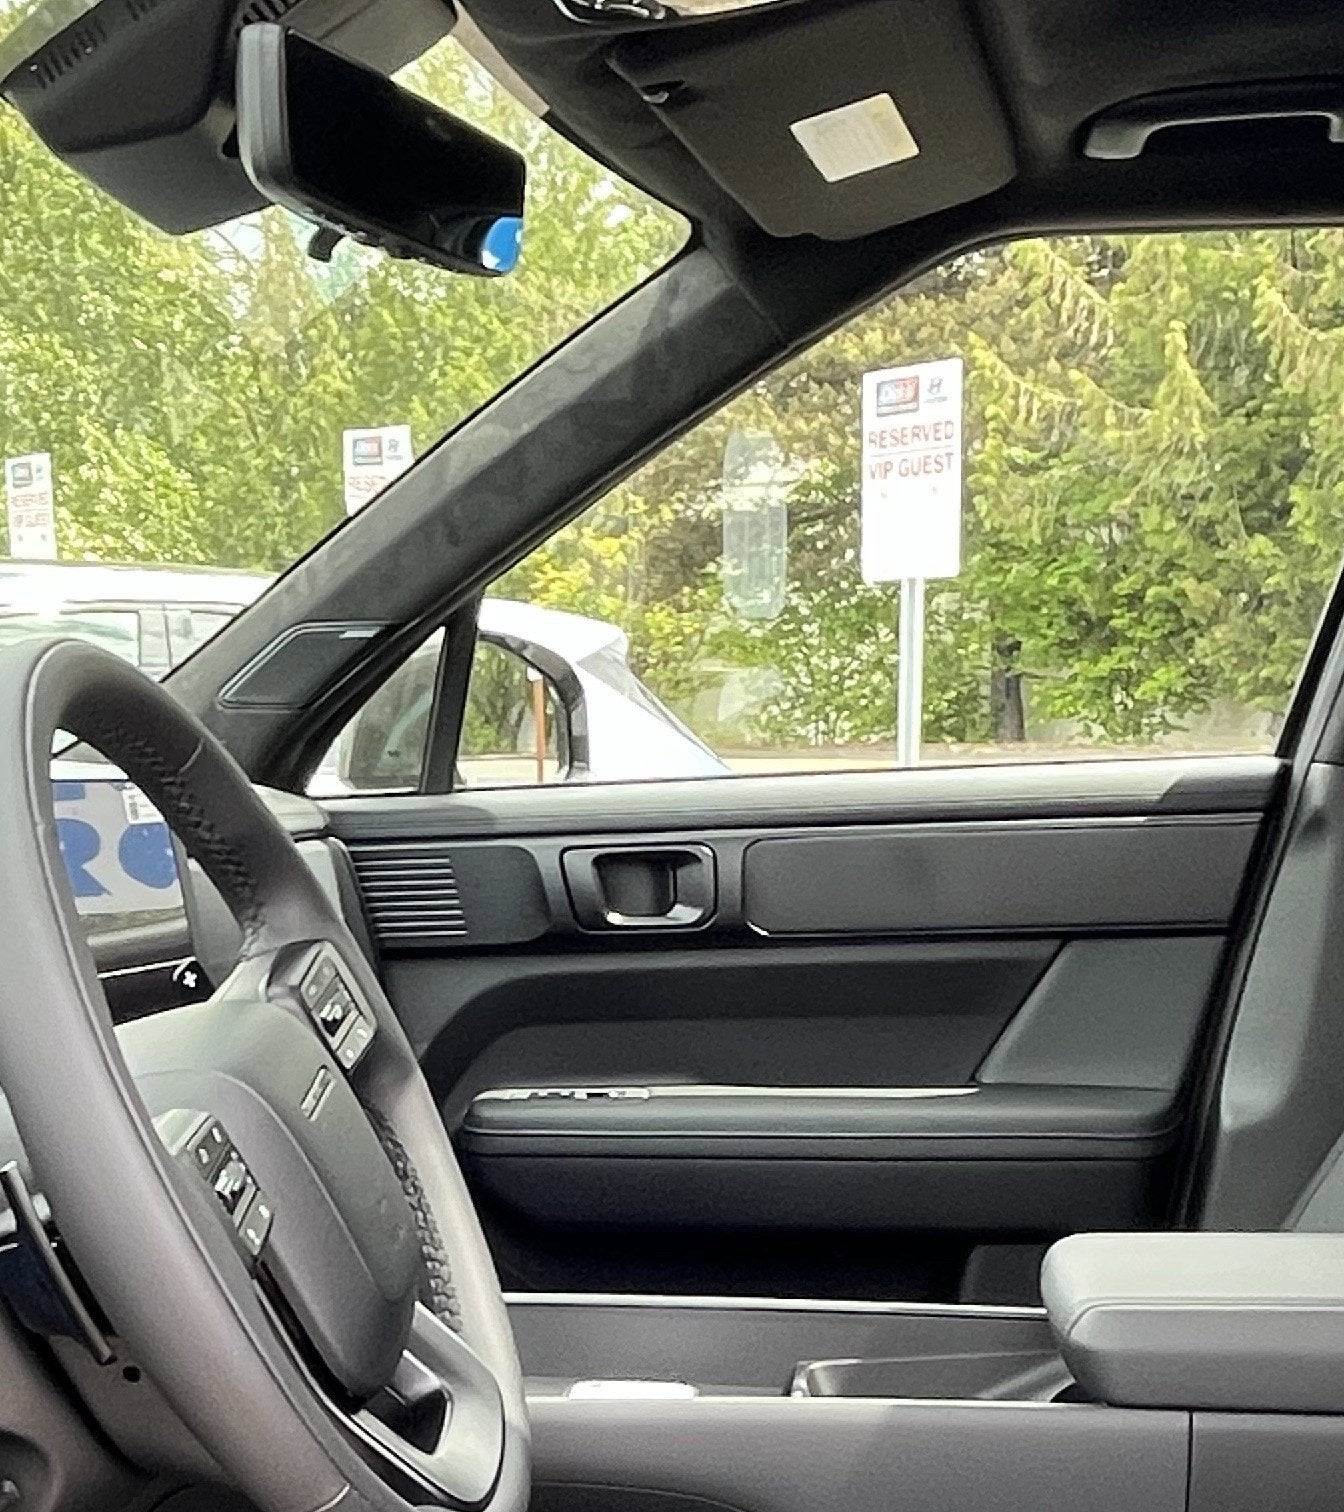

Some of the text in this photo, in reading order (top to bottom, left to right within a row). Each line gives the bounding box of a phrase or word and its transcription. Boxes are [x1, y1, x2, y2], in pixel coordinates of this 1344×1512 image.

[868, 420, 954, 449] RESERVED
[869, 452, 954, 480] VIP GUEST
